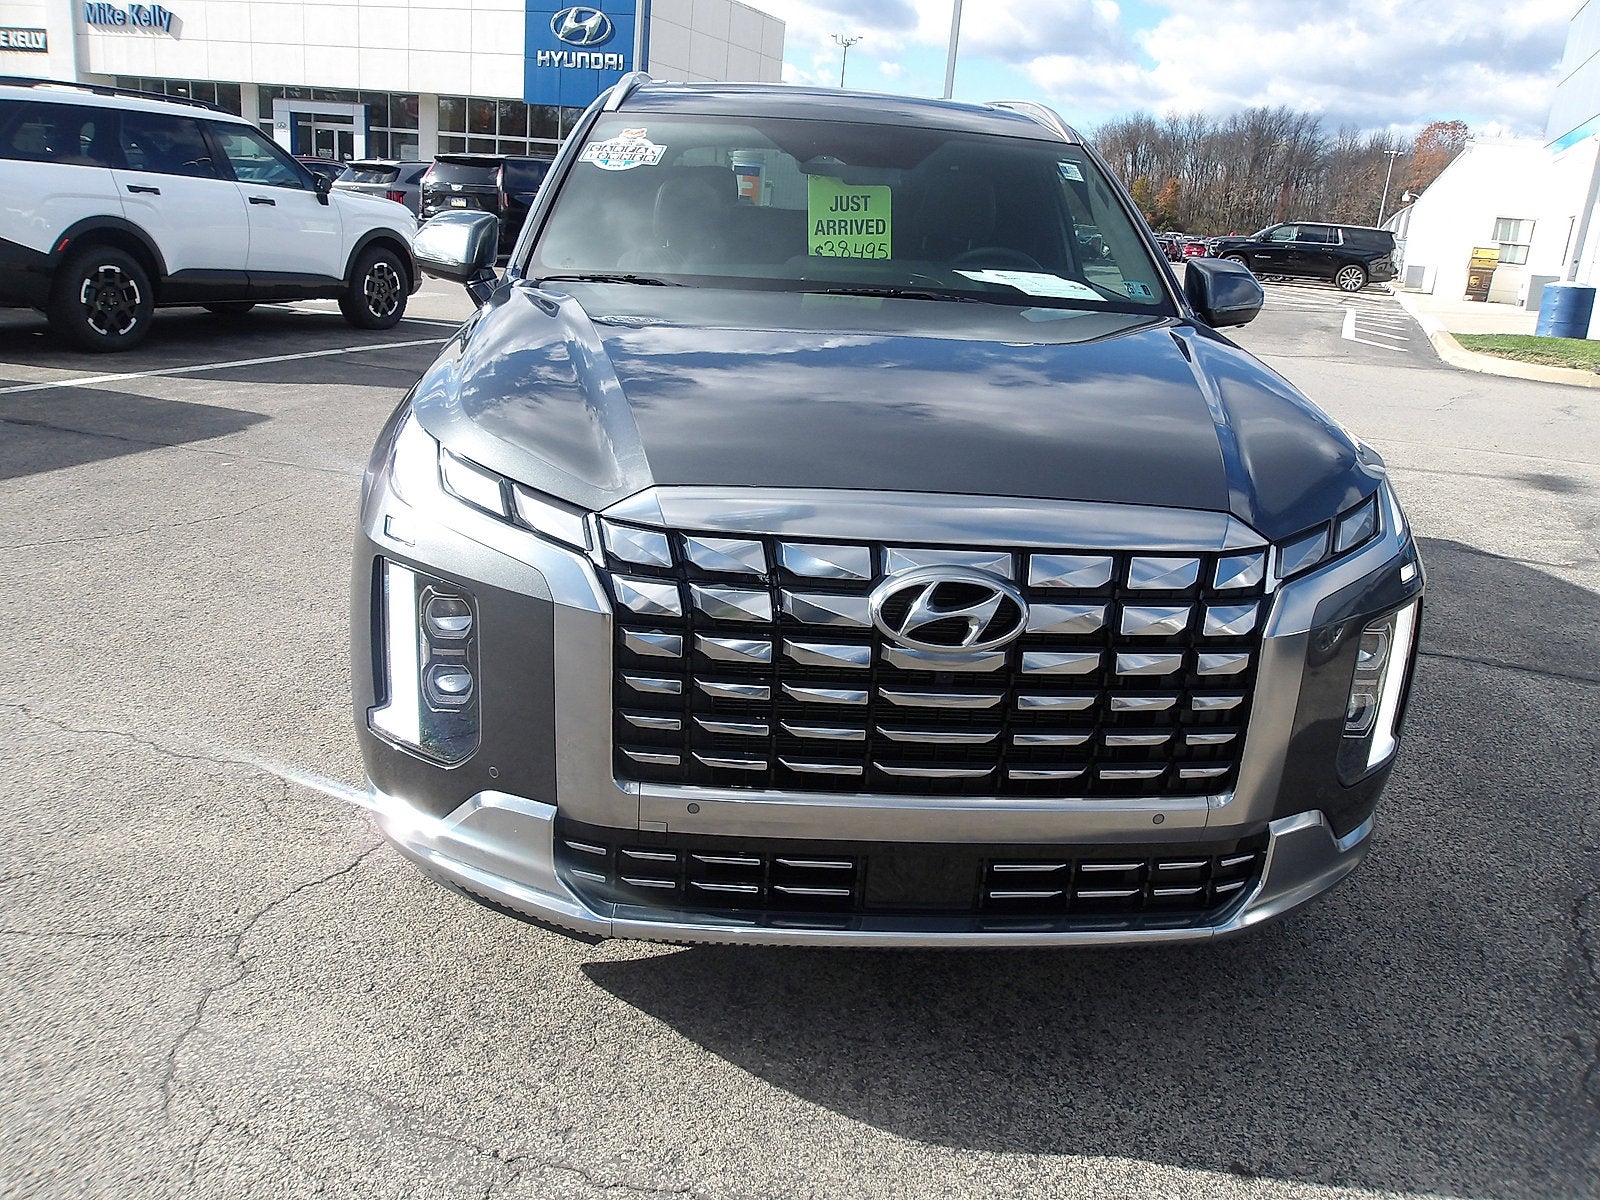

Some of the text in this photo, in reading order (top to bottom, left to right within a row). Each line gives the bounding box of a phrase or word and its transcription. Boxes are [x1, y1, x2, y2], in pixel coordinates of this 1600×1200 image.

[84, 2, 173, 32] Mike Kelly
[9, 31, 46, 48] KELLY
[537, 50, 624, 71] HYUNDAI
[829, 195, 871, 212] JUST
[814, 219, 886, 236] ARRIVED
